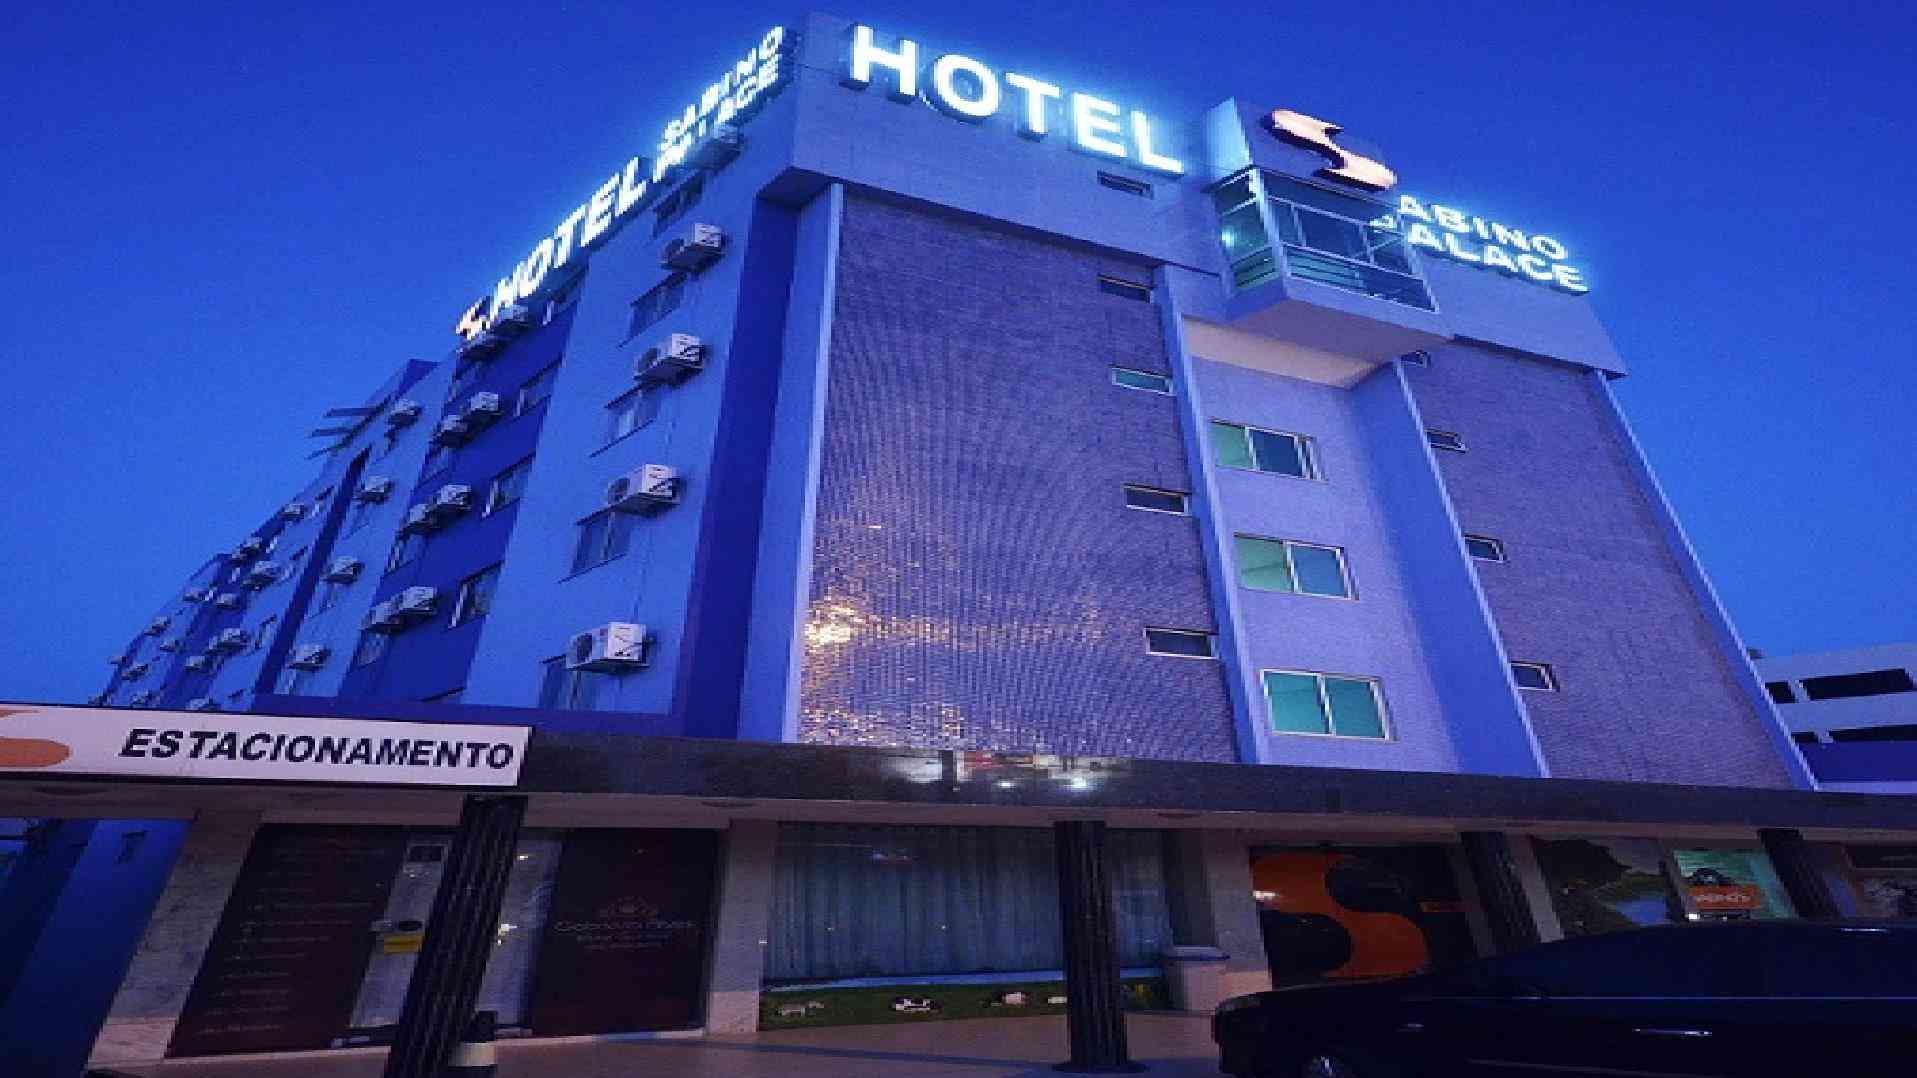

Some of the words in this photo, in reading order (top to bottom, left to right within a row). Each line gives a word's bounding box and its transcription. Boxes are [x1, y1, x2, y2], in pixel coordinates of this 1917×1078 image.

[852, 24, 1185, 175] HOTEL
[488, 156, 647, 327] HOTEL
[1399, 194, 1569, 260] ABINO
[119, 727, 514, 769] ESTACIONAMENTO
